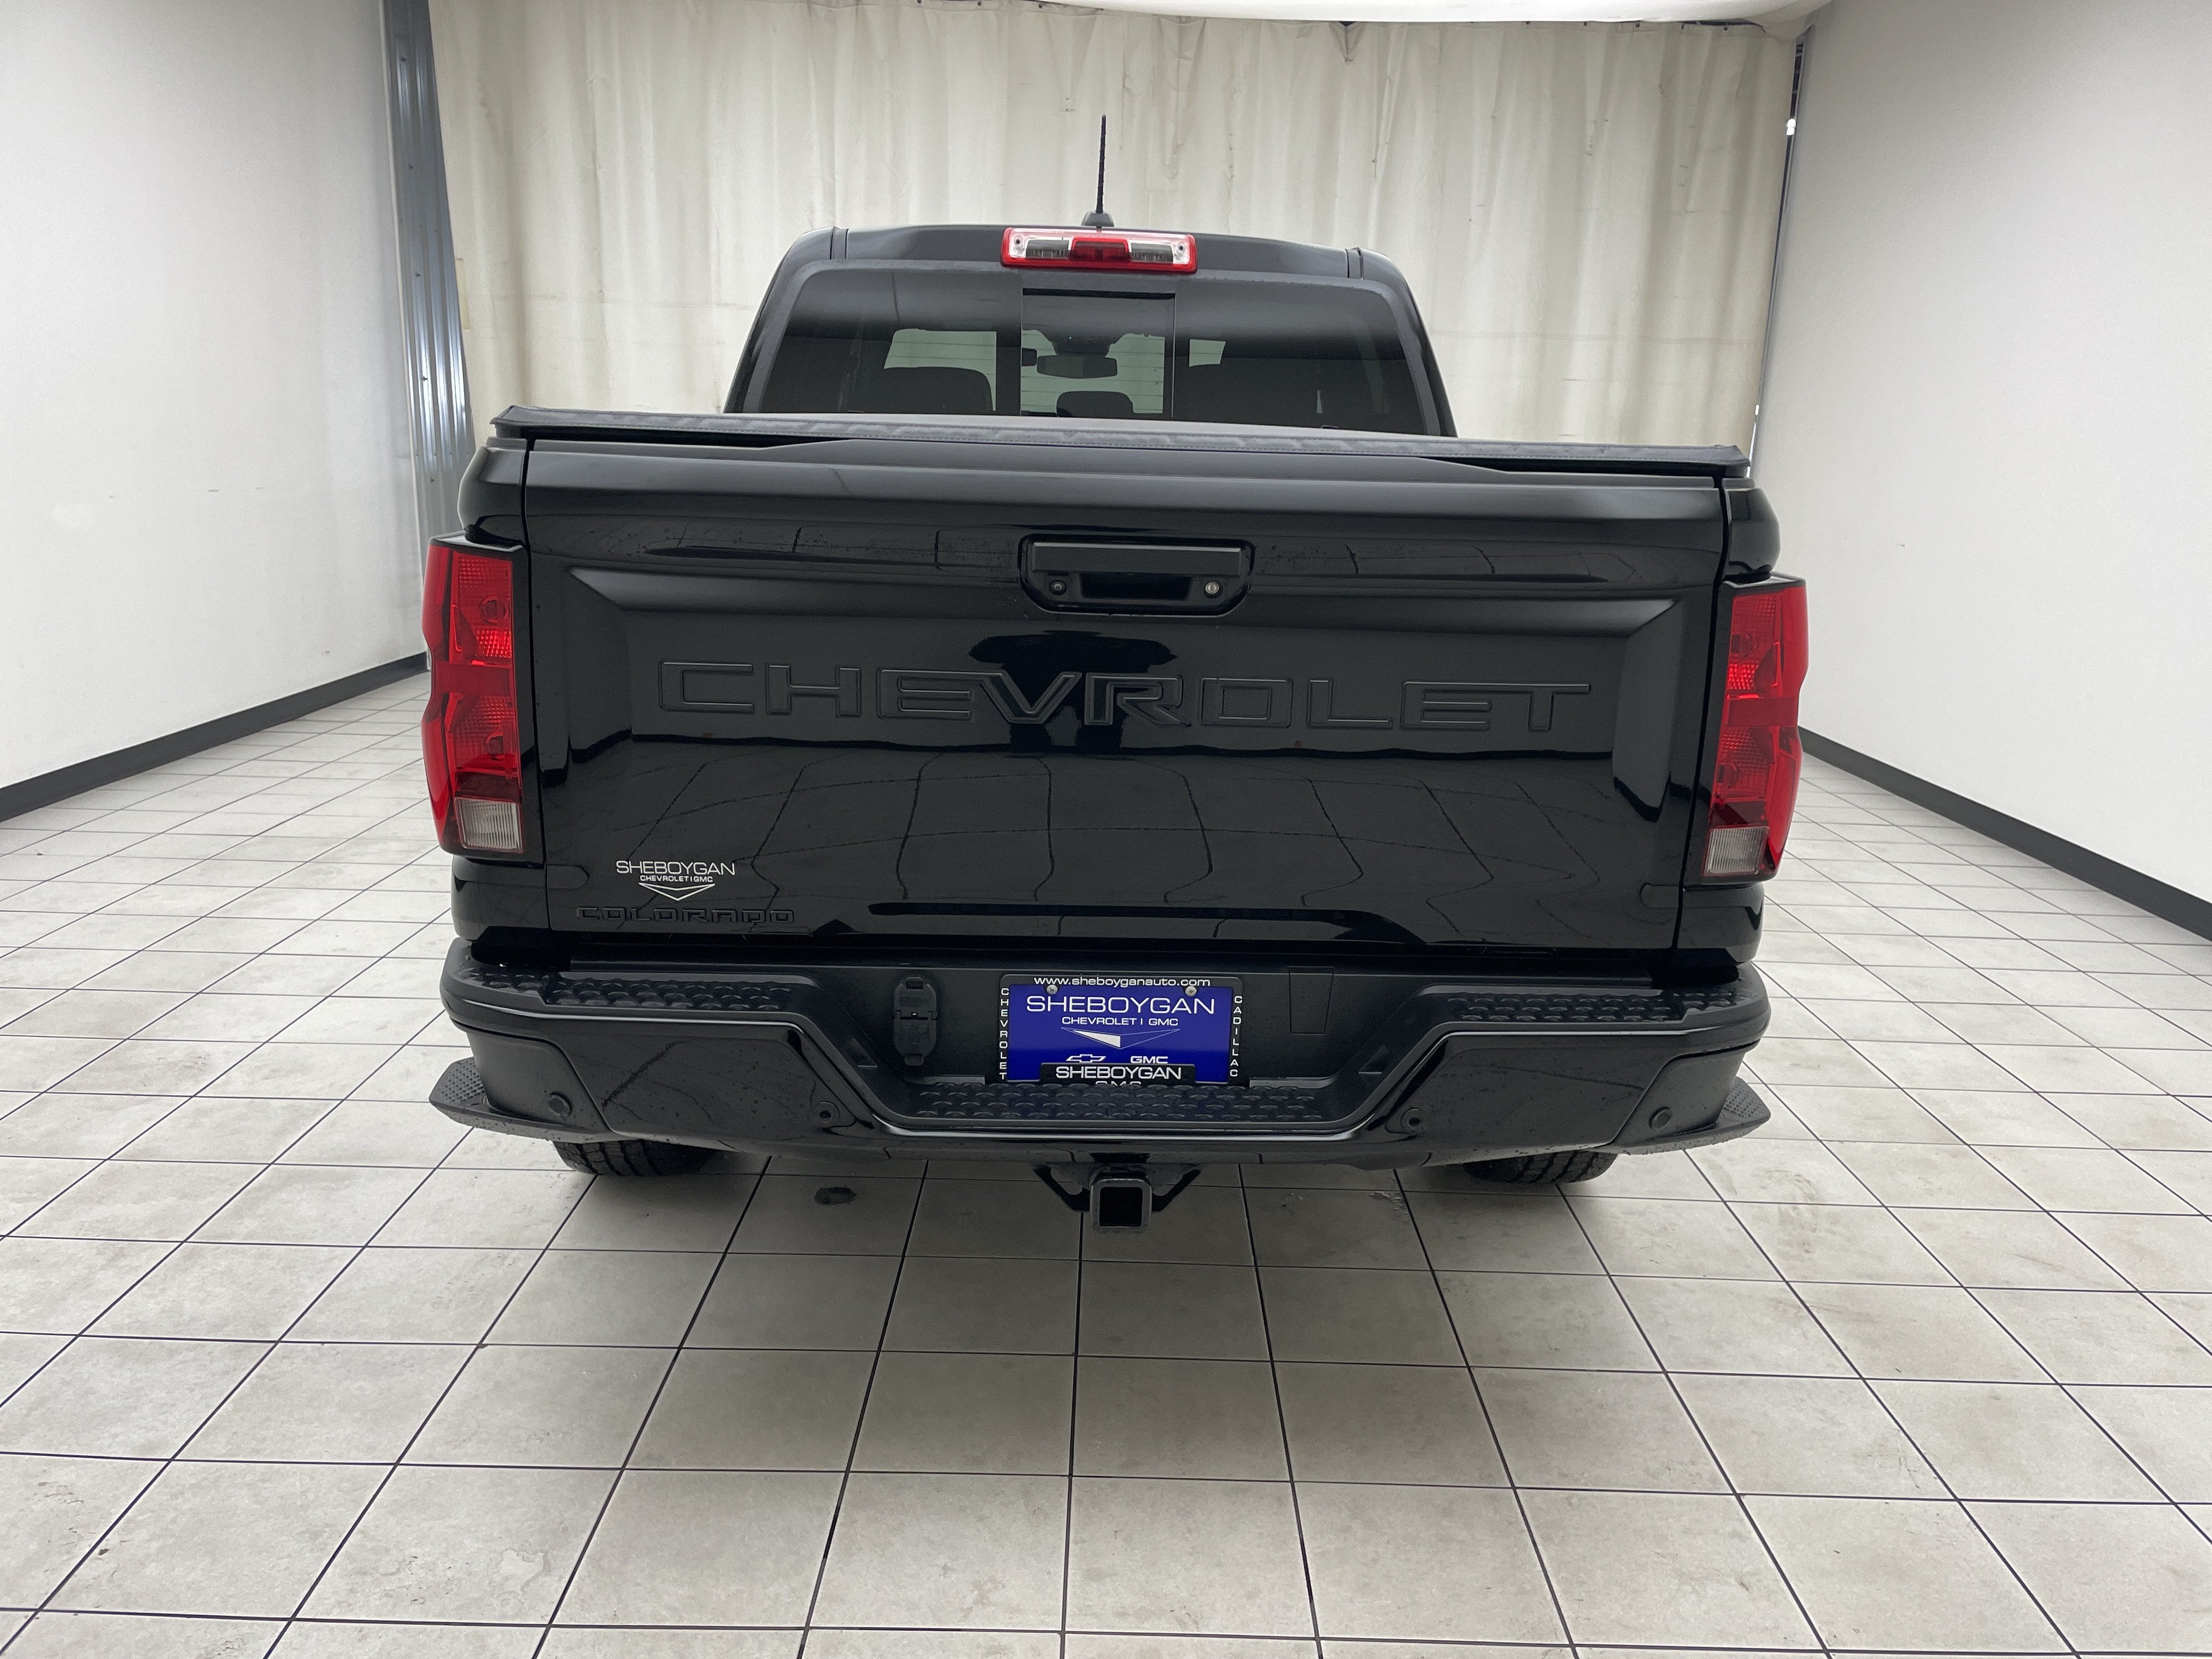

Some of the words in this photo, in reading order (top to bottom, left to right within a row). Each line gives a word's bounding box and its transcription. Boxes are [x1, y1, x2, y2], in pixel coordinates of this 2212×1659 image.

[658, 662, 1591, 732] CHEVROLET
[616, 860, 735, 876] SHEBOYGAN
[576, 906, 794, 923] COLORADO
[1034, 975, 1211, 988] www.sheboyganauto.com
[1026, 995, 1215, 1015] SHEBOYGAN
[1062, 1017, 1137, 1025] CHEVROLET
[1148, 1018, 1179, 1026] GMC
[999, 988, 1009, 1080] CHEVROLET
[1229, 995, 1243, 1077] CADILLAC
[1130, 1056, 1169, 1064] GMC
[1056, 1065, 1182, 1080] SHEBOYGAN
